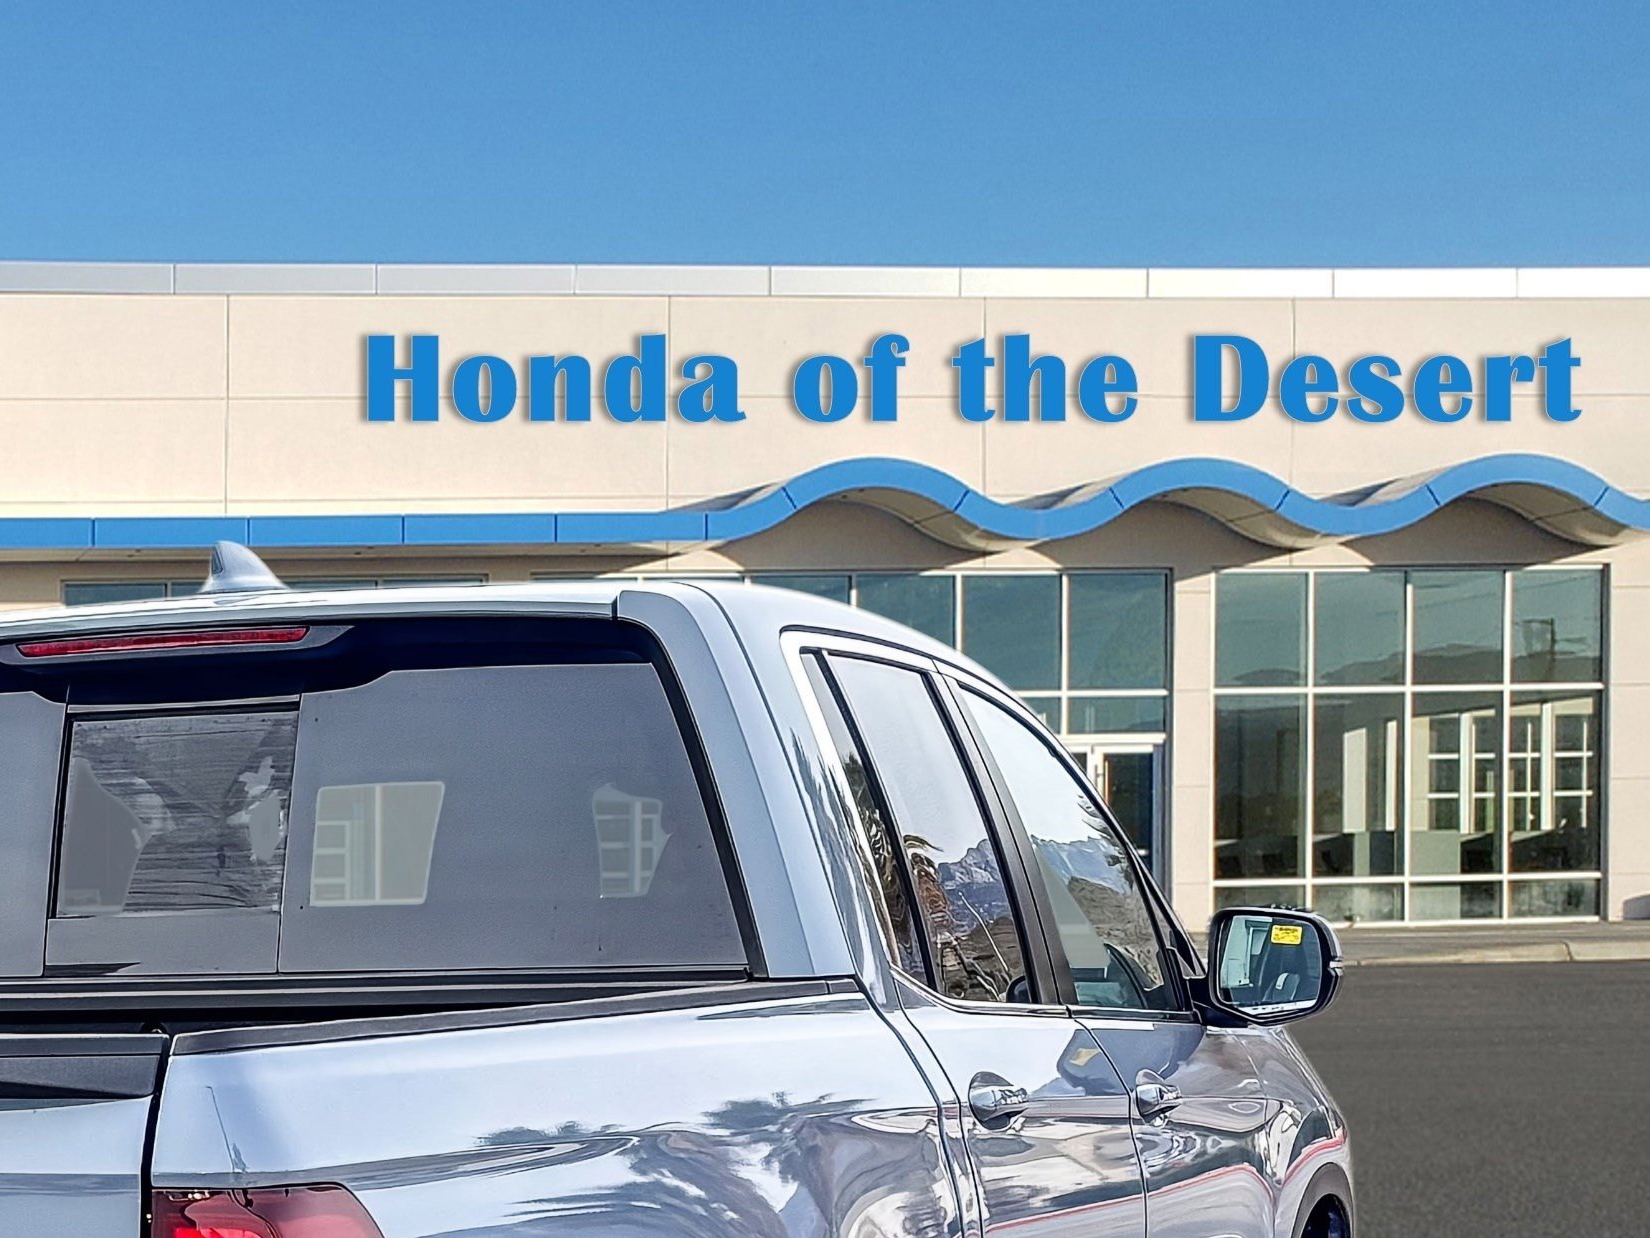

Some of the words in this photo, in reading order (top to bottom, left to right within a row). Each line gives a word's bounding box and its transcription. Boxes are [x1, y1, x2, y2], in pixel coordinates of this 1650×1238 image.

[365, 333, 747, 423] Honda
[793, 333, 911, 423] of
[951, 333, 1139, 423] the
[1193, 334, 1583, 423] Desert
